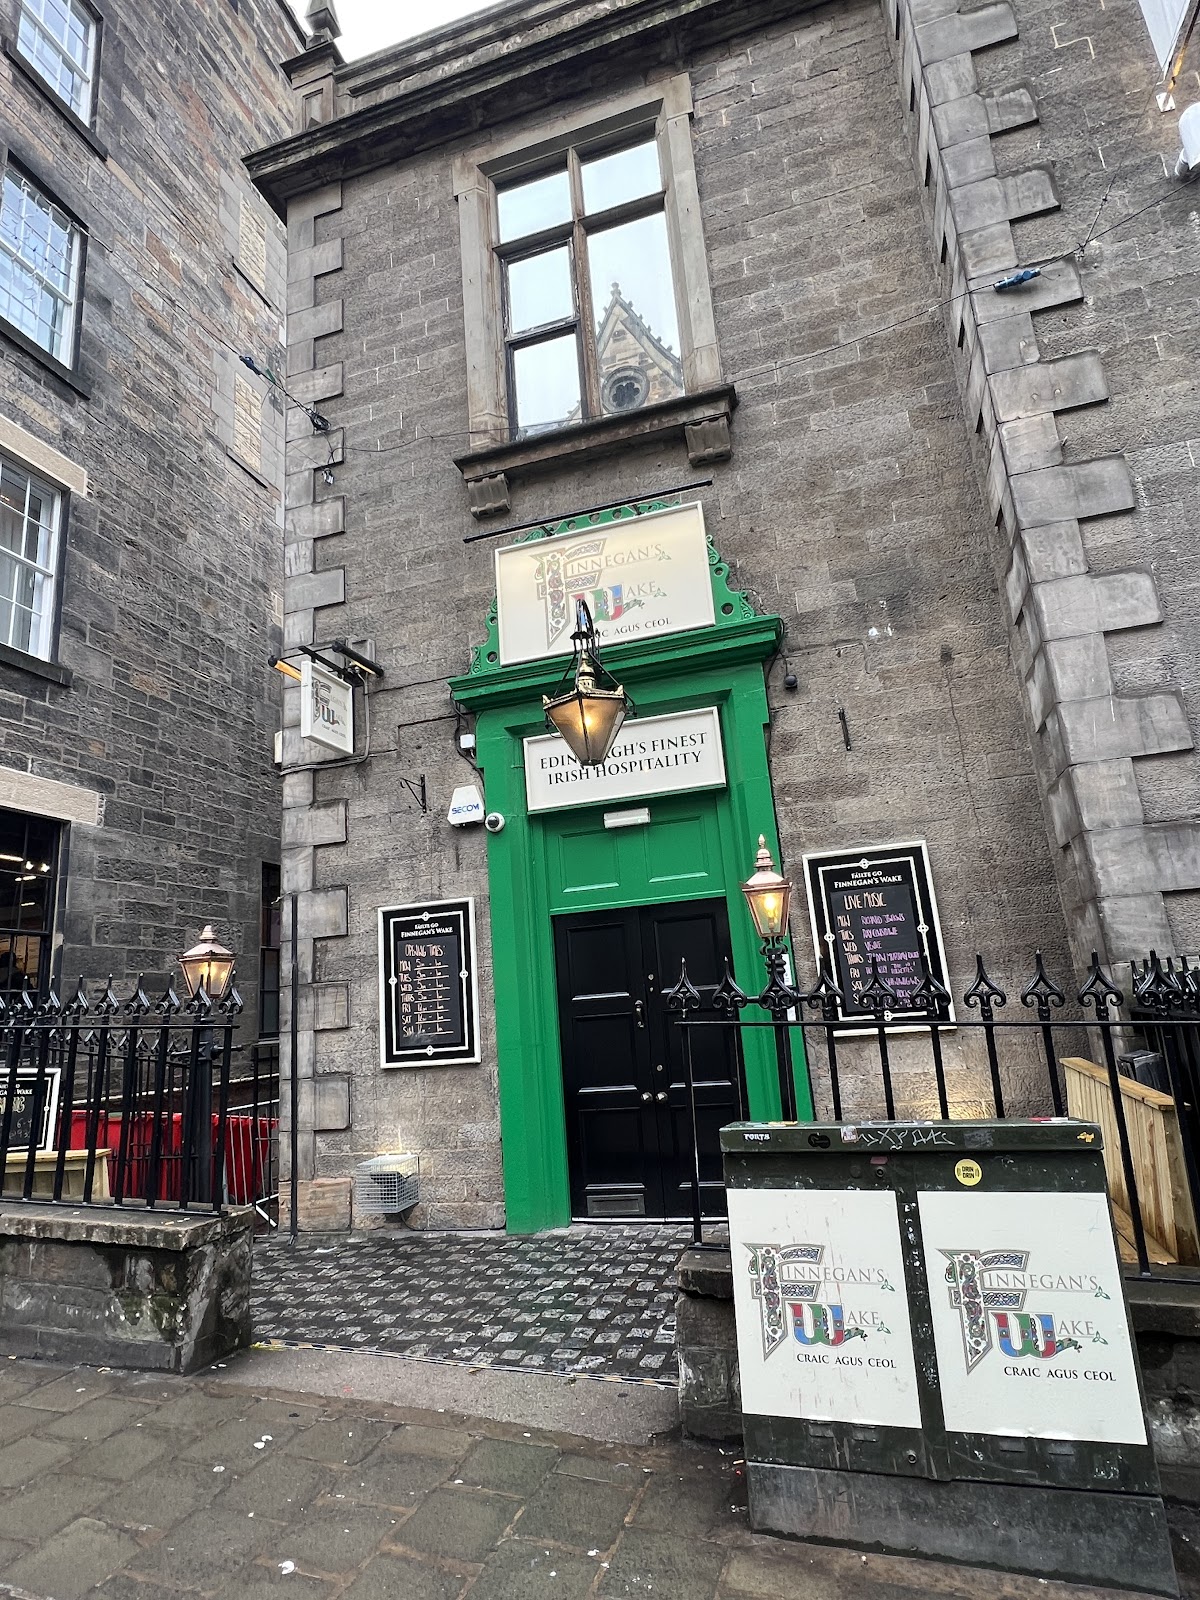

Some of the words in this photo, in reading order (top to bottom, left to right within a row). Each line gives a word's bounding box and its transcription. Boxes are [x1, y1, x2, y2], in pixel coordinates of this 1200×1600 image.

[530, 538, 662, 650] FINNEGAN'S
[614, 624, 640, 636] AGUS
[644, 617, 672, 629] CEOL
[540, 742, 646, 769] EDINGH'S
[651, 732, 707, 751] FINEST
[548, 768, 591, 785] IRISH
[595, 750, 703, 778] HOSPITALITY
[452, 803, 480, 815] SECOM
[834, 876, 880, 889] FINNEGAN'S
[880, 875, 902, 883] WAKE
[844, 894, 862, 910] LIVE
[863, 892, 887, 908] MUSIC
[837, 914, 851, 927] MON
[401, 929, 435, 938] FINNEGAN'S
[436, 926, 453, 934] WAKE
[838, 929, 854, 940] TUES
[405, 944, 427, 957] OPENING
[843, 942, 857, 952] WED
[400, 960, 411, 971] MON
[849, 967, 860, 978] FRI
[400, 983, 412, 992] WED
[402, 1003, 411, 1012] FRI
[402, 1014, 412, 1024] SAT
[742, 1243, 886, 1362] FINNEGAN'S
[935, 1248, 1098, 1376] FINNEGAN'S
[788, 1303, 880, 1346] WAKE
[990, 1312, 1095, 1358] WAKE
[796, 1353, 829, 1364] CRAIC
[835, 1355, 863, 1367] AGUS
[867, 1357, 897, 1369] CEOL
[1003, 1366, 1041, 1378] CRAIC
[1047, 1368, 1078, 1380] AGUS
[1084, 1370, 1117, 1382] CEOL
